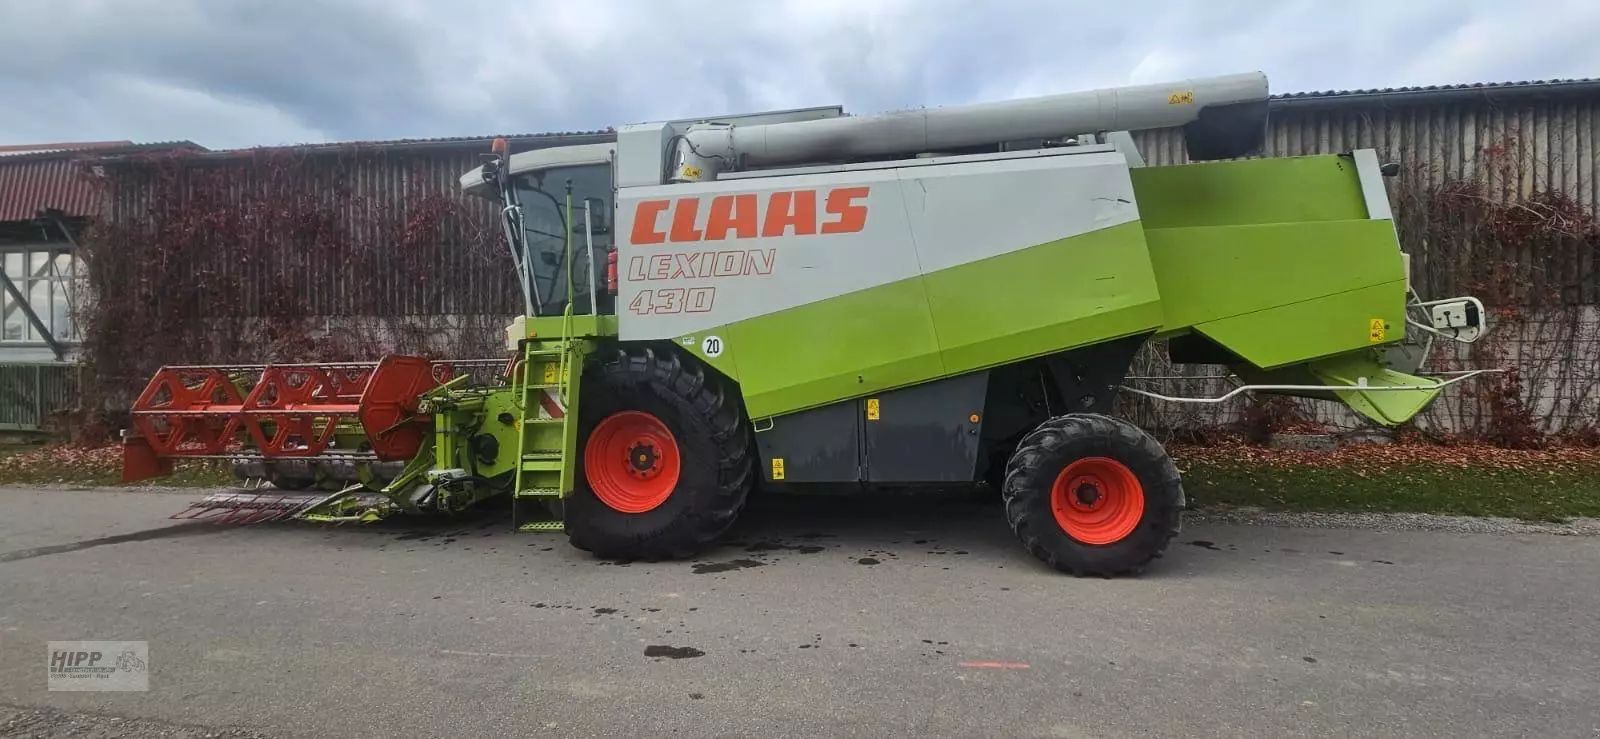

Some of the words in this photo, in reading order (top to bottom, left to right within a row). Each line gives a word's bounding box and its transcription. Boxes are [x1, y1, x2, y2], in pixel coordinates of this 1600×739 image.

[630, 186, 870, 244] CLAAS
[628, 248, 776, 282] LEXION
[628, 286, 716, 315] 430
[706, 338, 720, 354] 20
